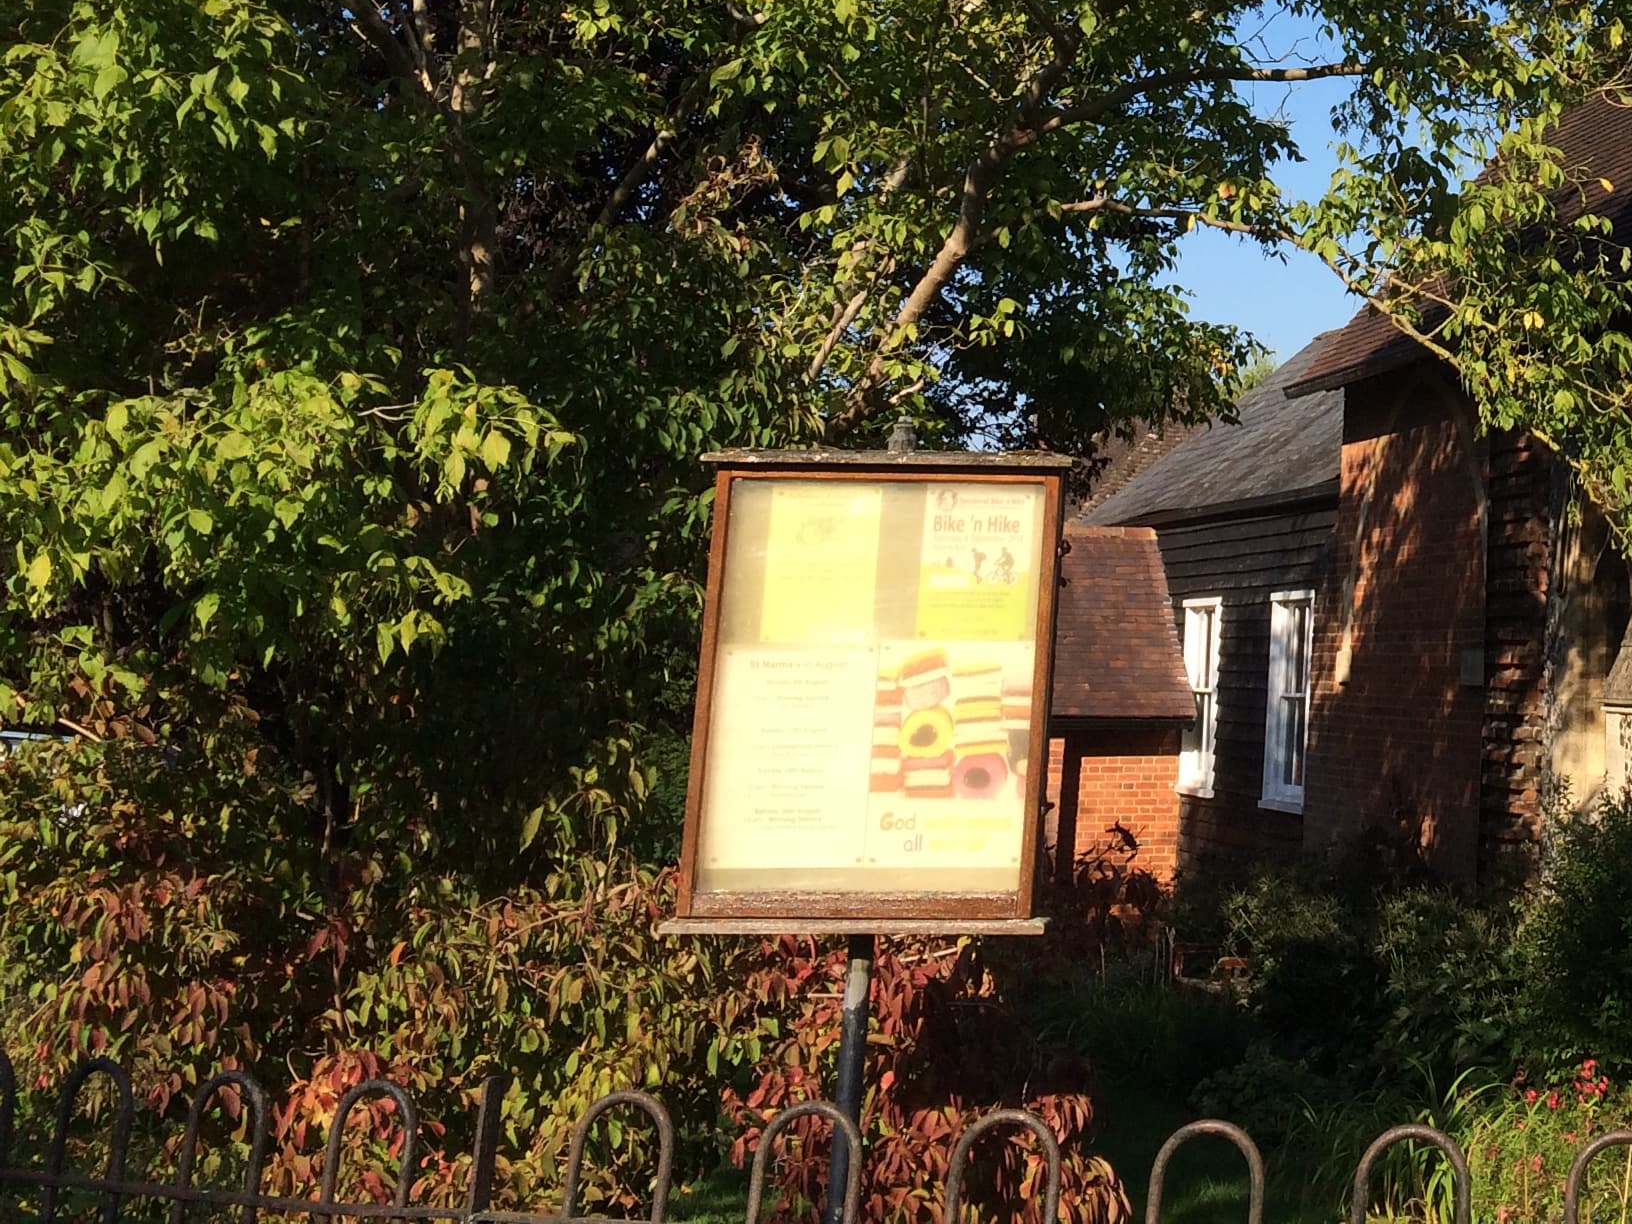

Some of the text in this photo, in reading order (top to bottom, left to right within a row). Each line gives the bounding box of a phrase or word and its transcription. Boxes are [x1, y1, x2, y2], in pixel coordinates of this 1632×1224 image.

[933, 514, 965, 533] Bike
[987, 514, 1020, 534] Hike
[879, 810, 917, 831] God
[903, 832, 923, 853] all
